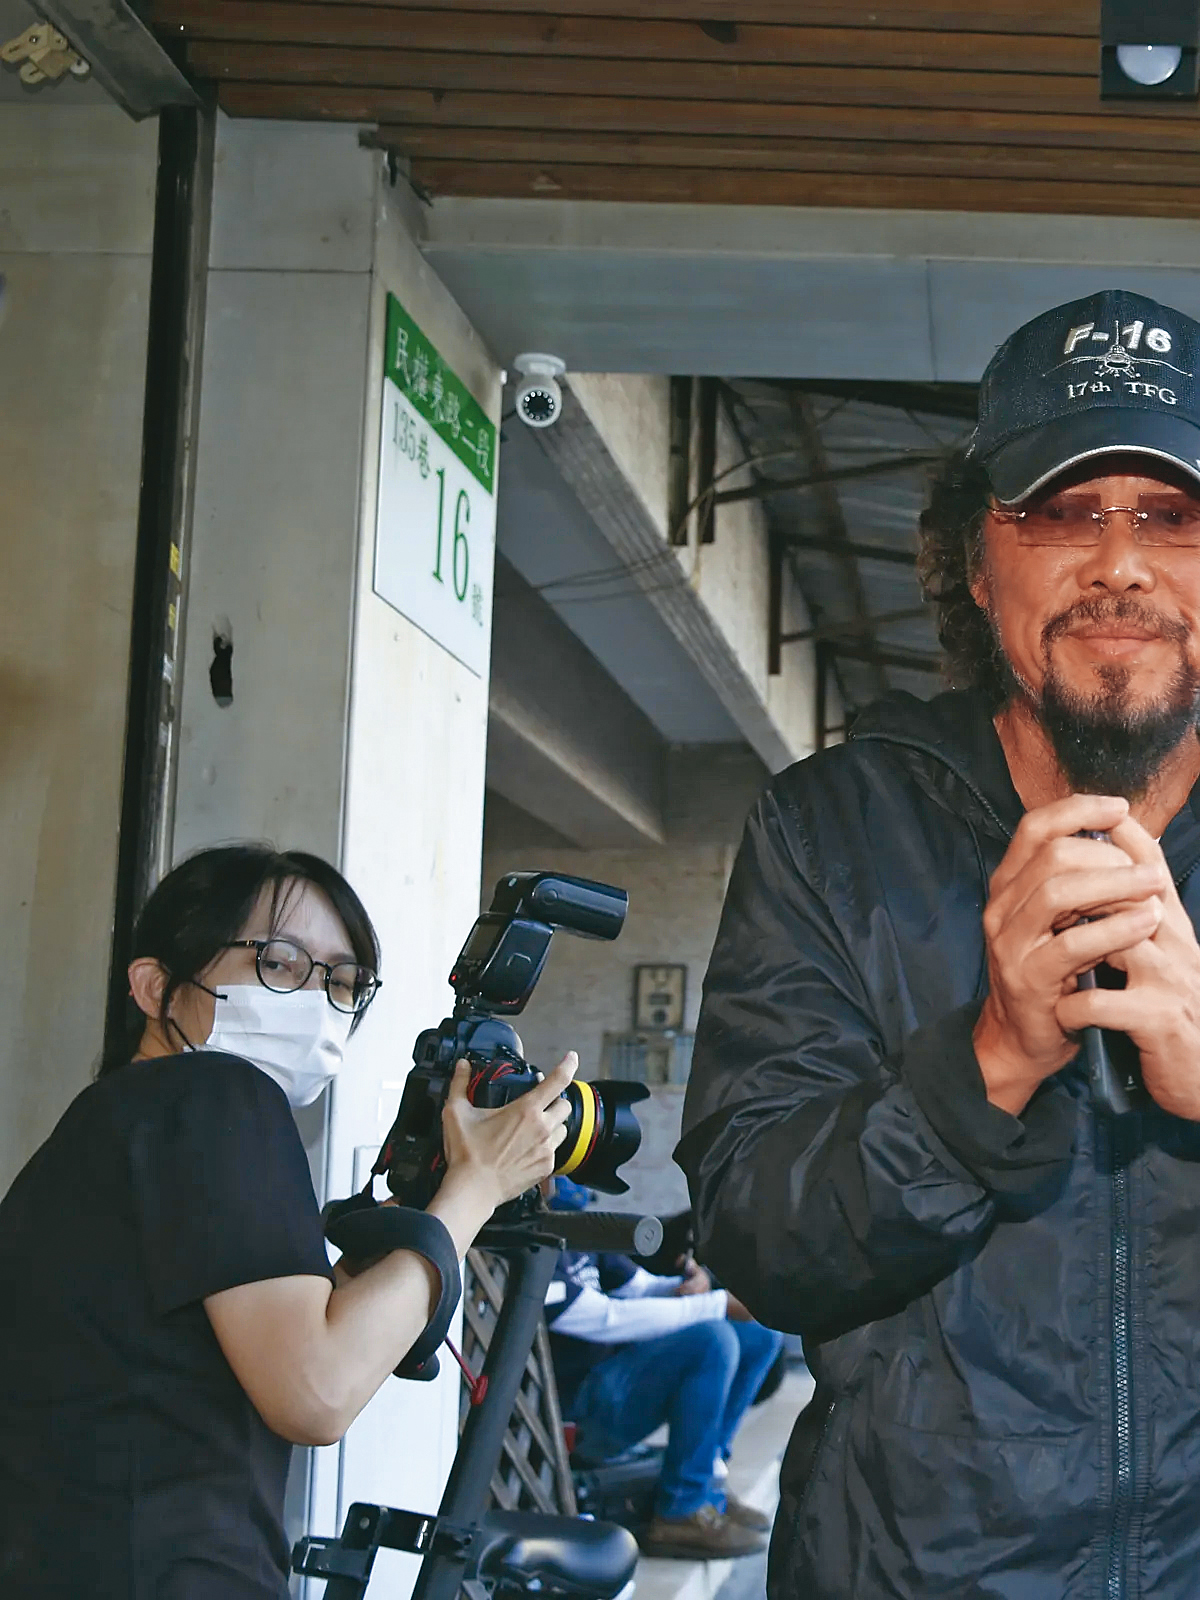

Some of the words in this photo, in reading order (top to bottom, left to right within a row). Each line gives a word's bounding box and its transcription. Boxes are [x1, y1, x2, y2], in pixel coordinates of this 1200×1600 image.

[1063, 320, 1173, 355] F-16
[1066, 381, 1111, 400] 17th
[1124, 381, 1179, 405] TFG
